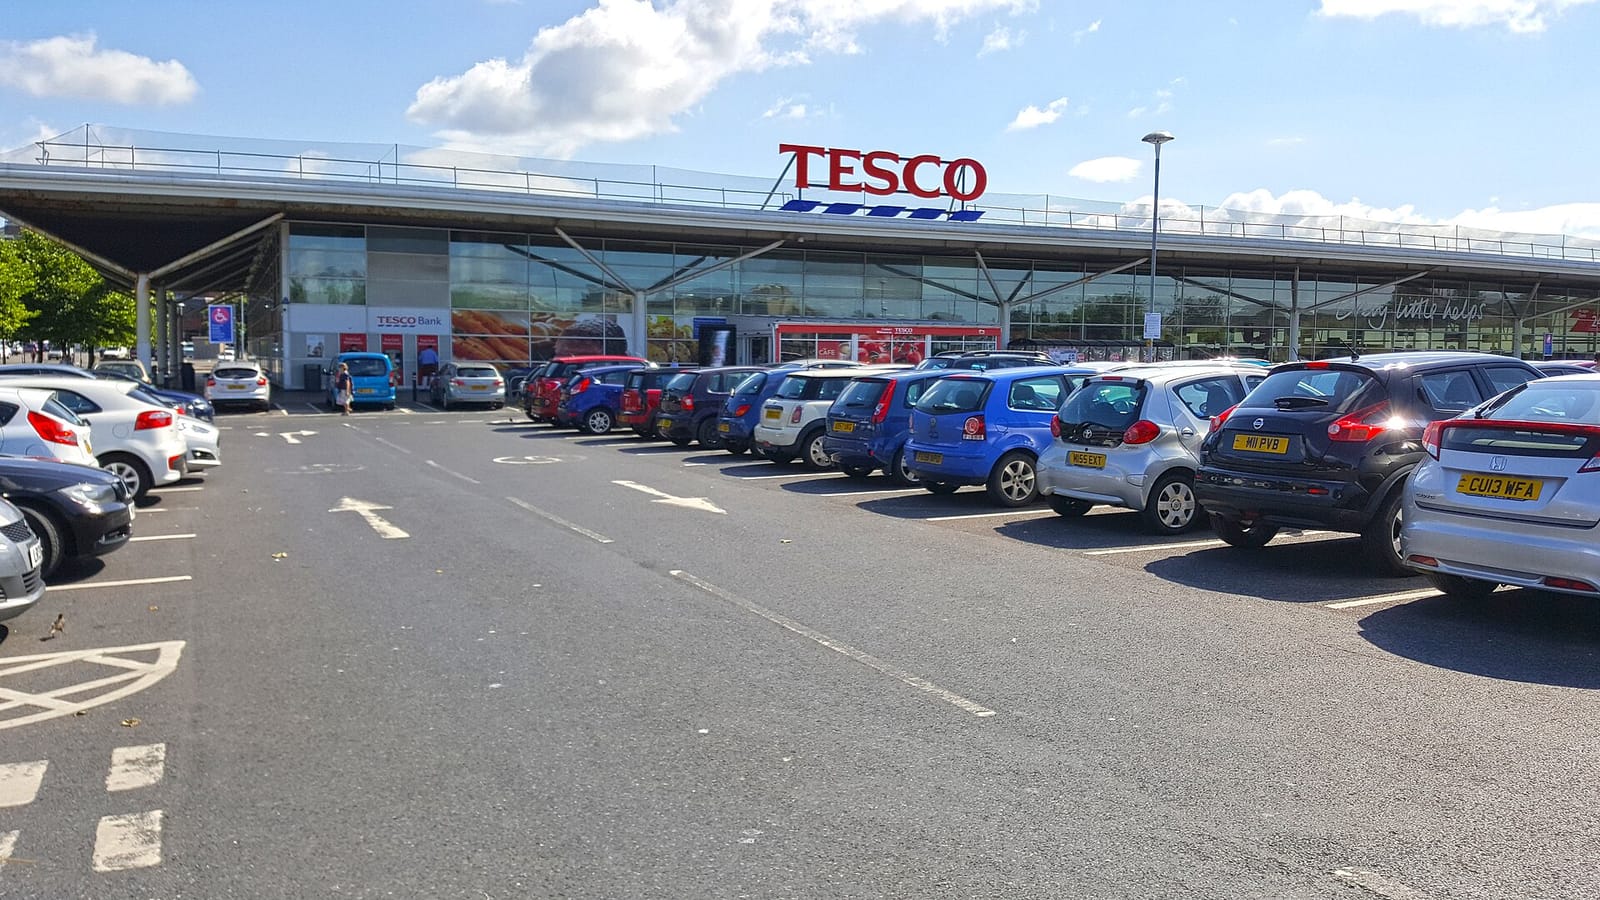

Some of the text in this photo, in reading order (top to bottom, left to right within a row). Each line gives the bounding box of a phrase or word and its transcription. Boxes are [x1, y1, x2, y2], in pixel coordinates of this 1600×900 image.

[779, 143, 988, 202] TESCO
[1396, 296, 1437, 320] little
[1442, 298, 1487, 327] helps
[376, 315, 442, 326] TESCO Bank
[1259, 437, 1280, 450] PVB
[1088, 455, 1102, 465] EXT
[1468, 477, 1534, 498] CU13 WFA
